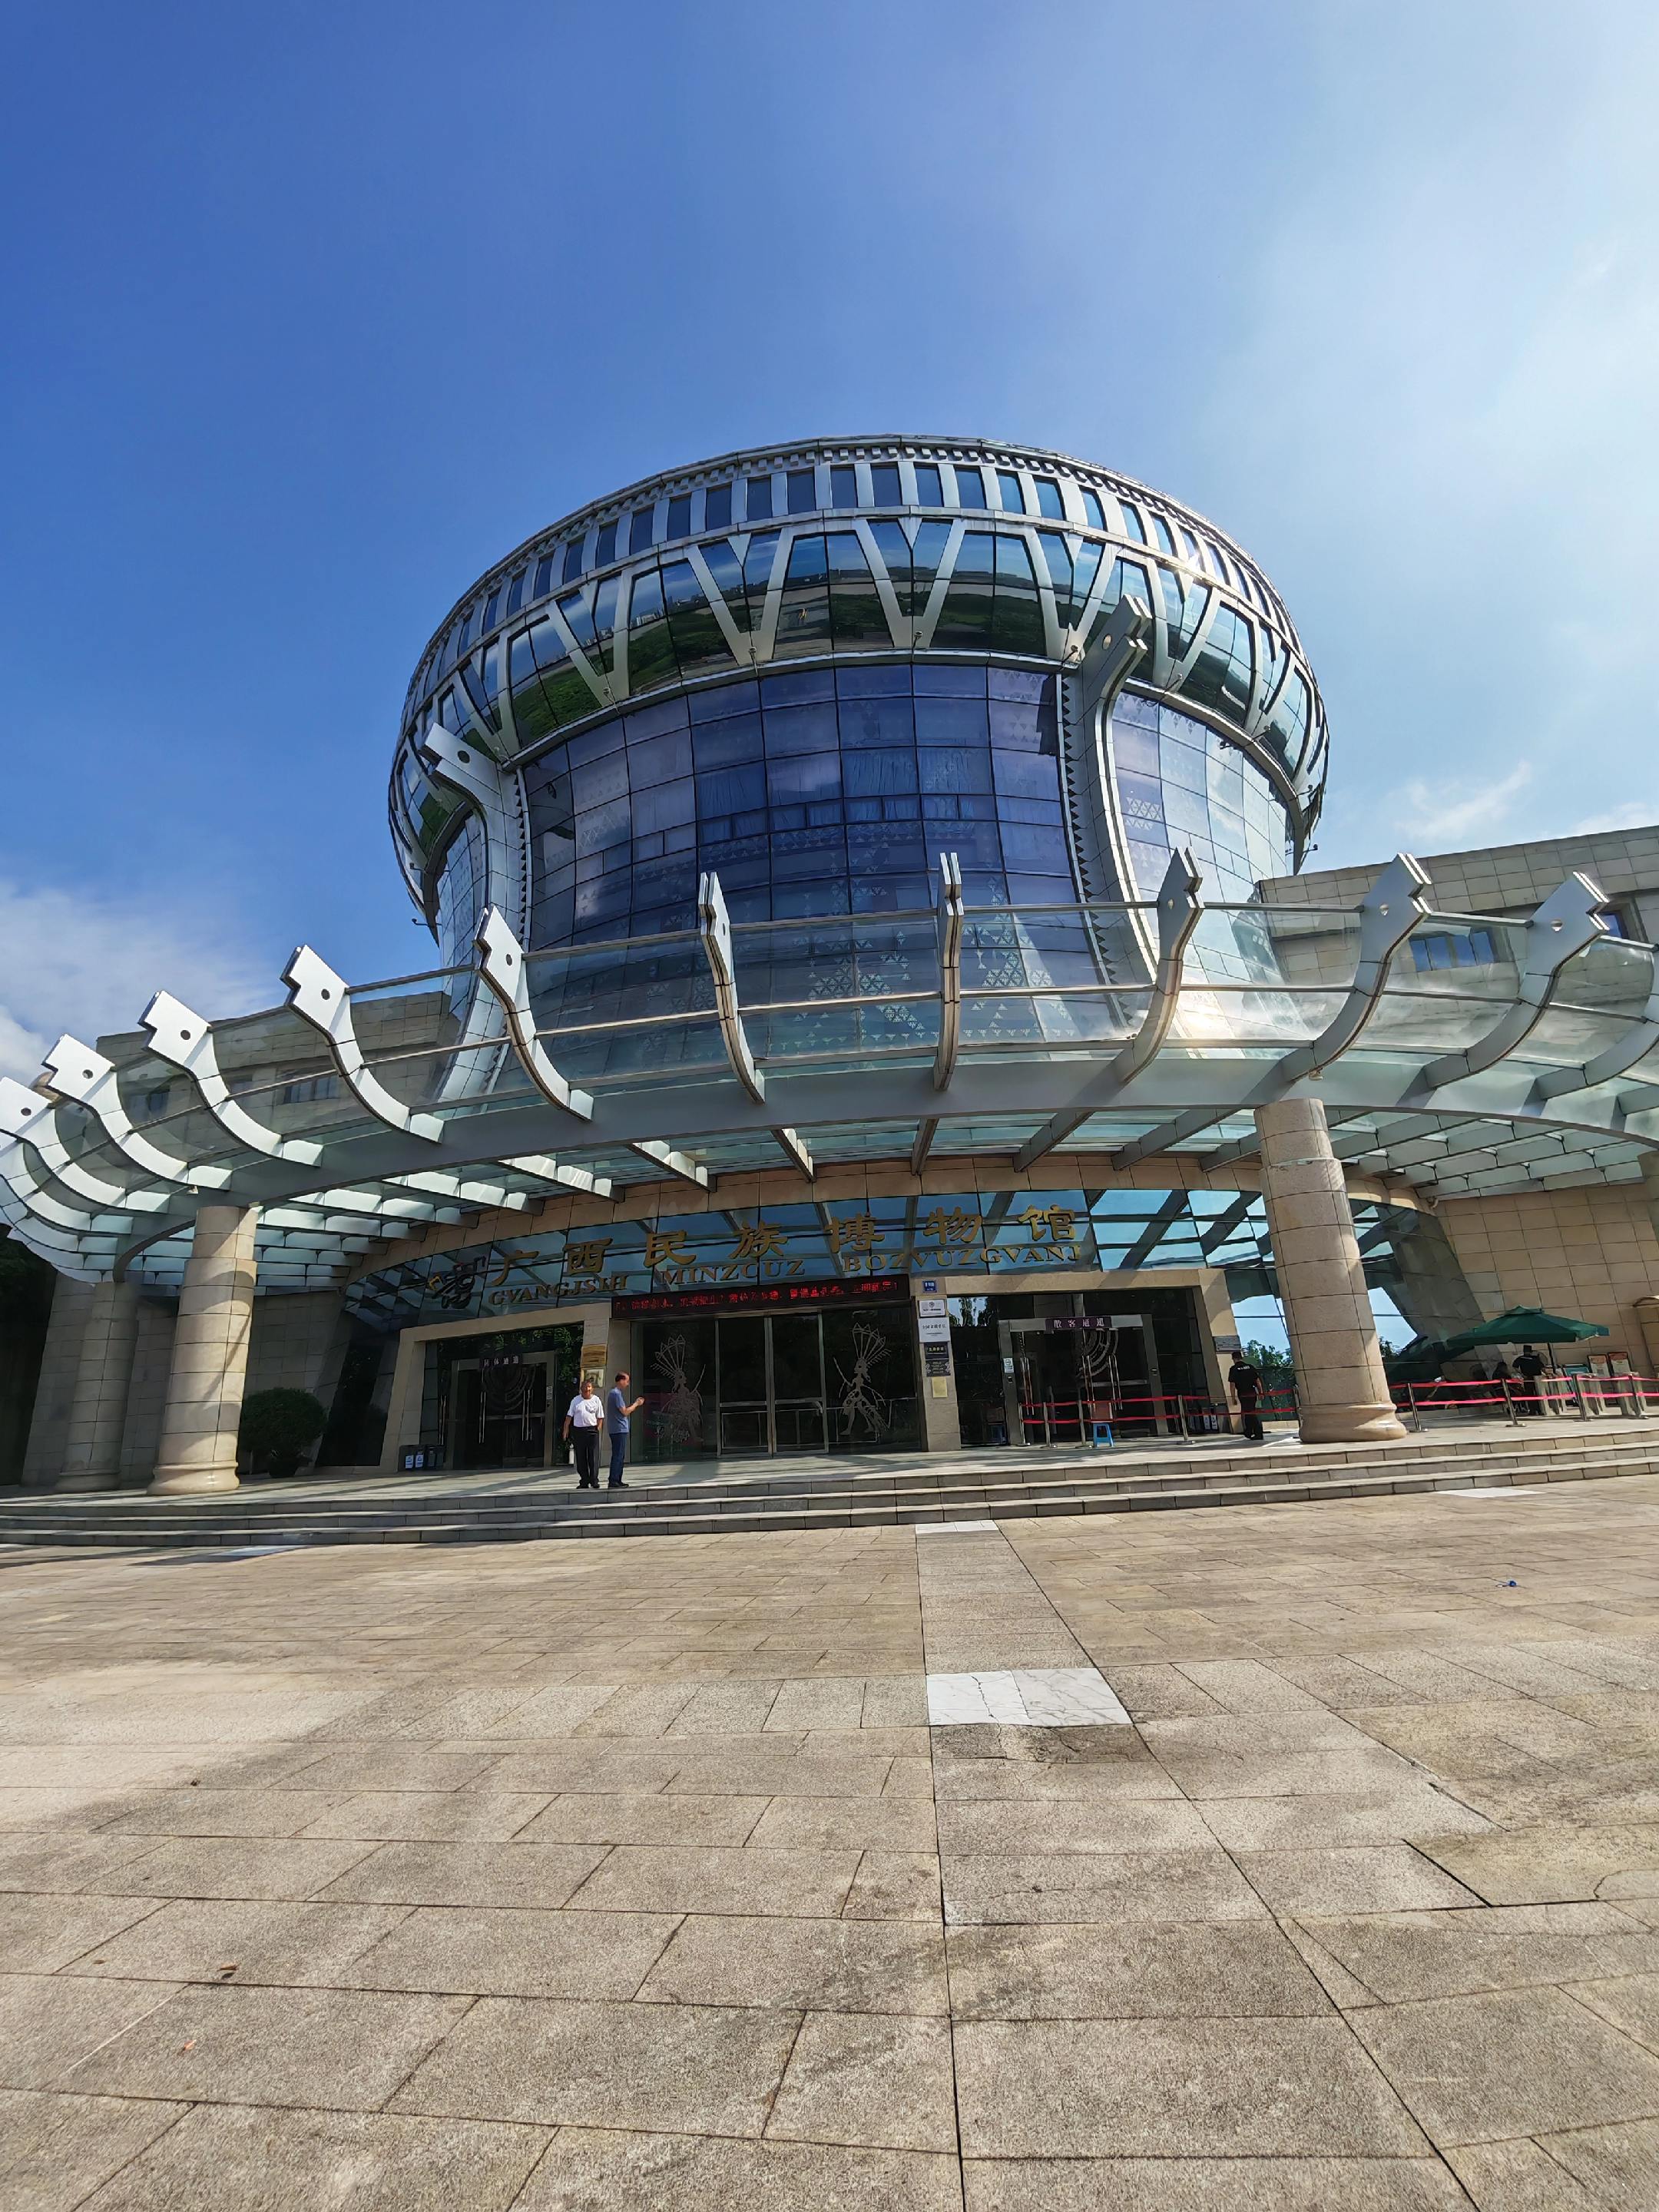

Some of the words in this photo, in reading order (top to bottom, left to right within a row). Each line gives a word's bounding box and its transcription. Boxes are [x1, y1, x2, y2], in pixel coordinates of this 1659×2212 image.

[488, 1274, 629, 1306] GVANGJSIH
[661, 1260, 806, 1285] MINZCUZ
[843, 1245, 1081, 1272] BOZVUZGVANJ
[492, 1204, 1075, 1286] 广西民族博物馆
